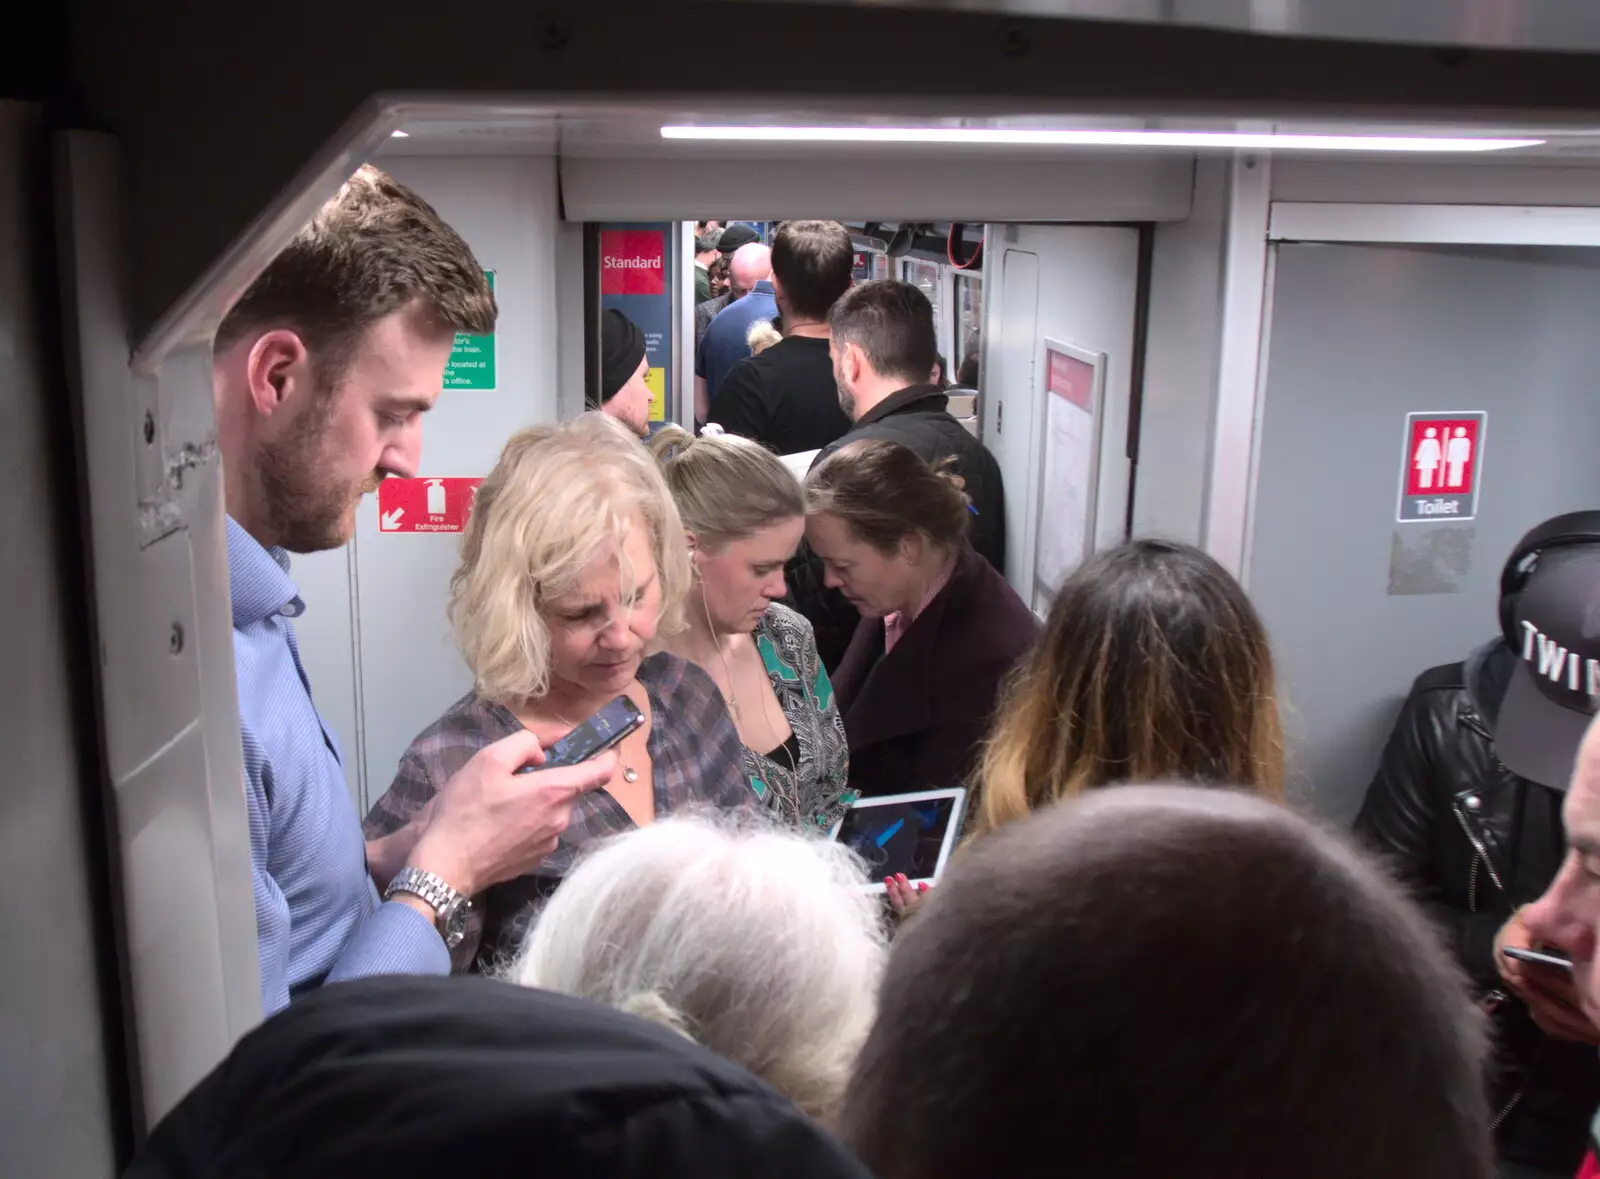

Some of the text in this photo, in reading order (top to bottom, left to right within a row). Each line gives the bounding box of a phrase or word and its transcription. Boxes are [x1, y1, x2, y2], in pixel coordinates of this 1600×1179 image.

[604, 255, 662, 269] Standard
[1415, 498, 1460, 515] Toilet
[415, 523, 460, 532] Extinguisher
